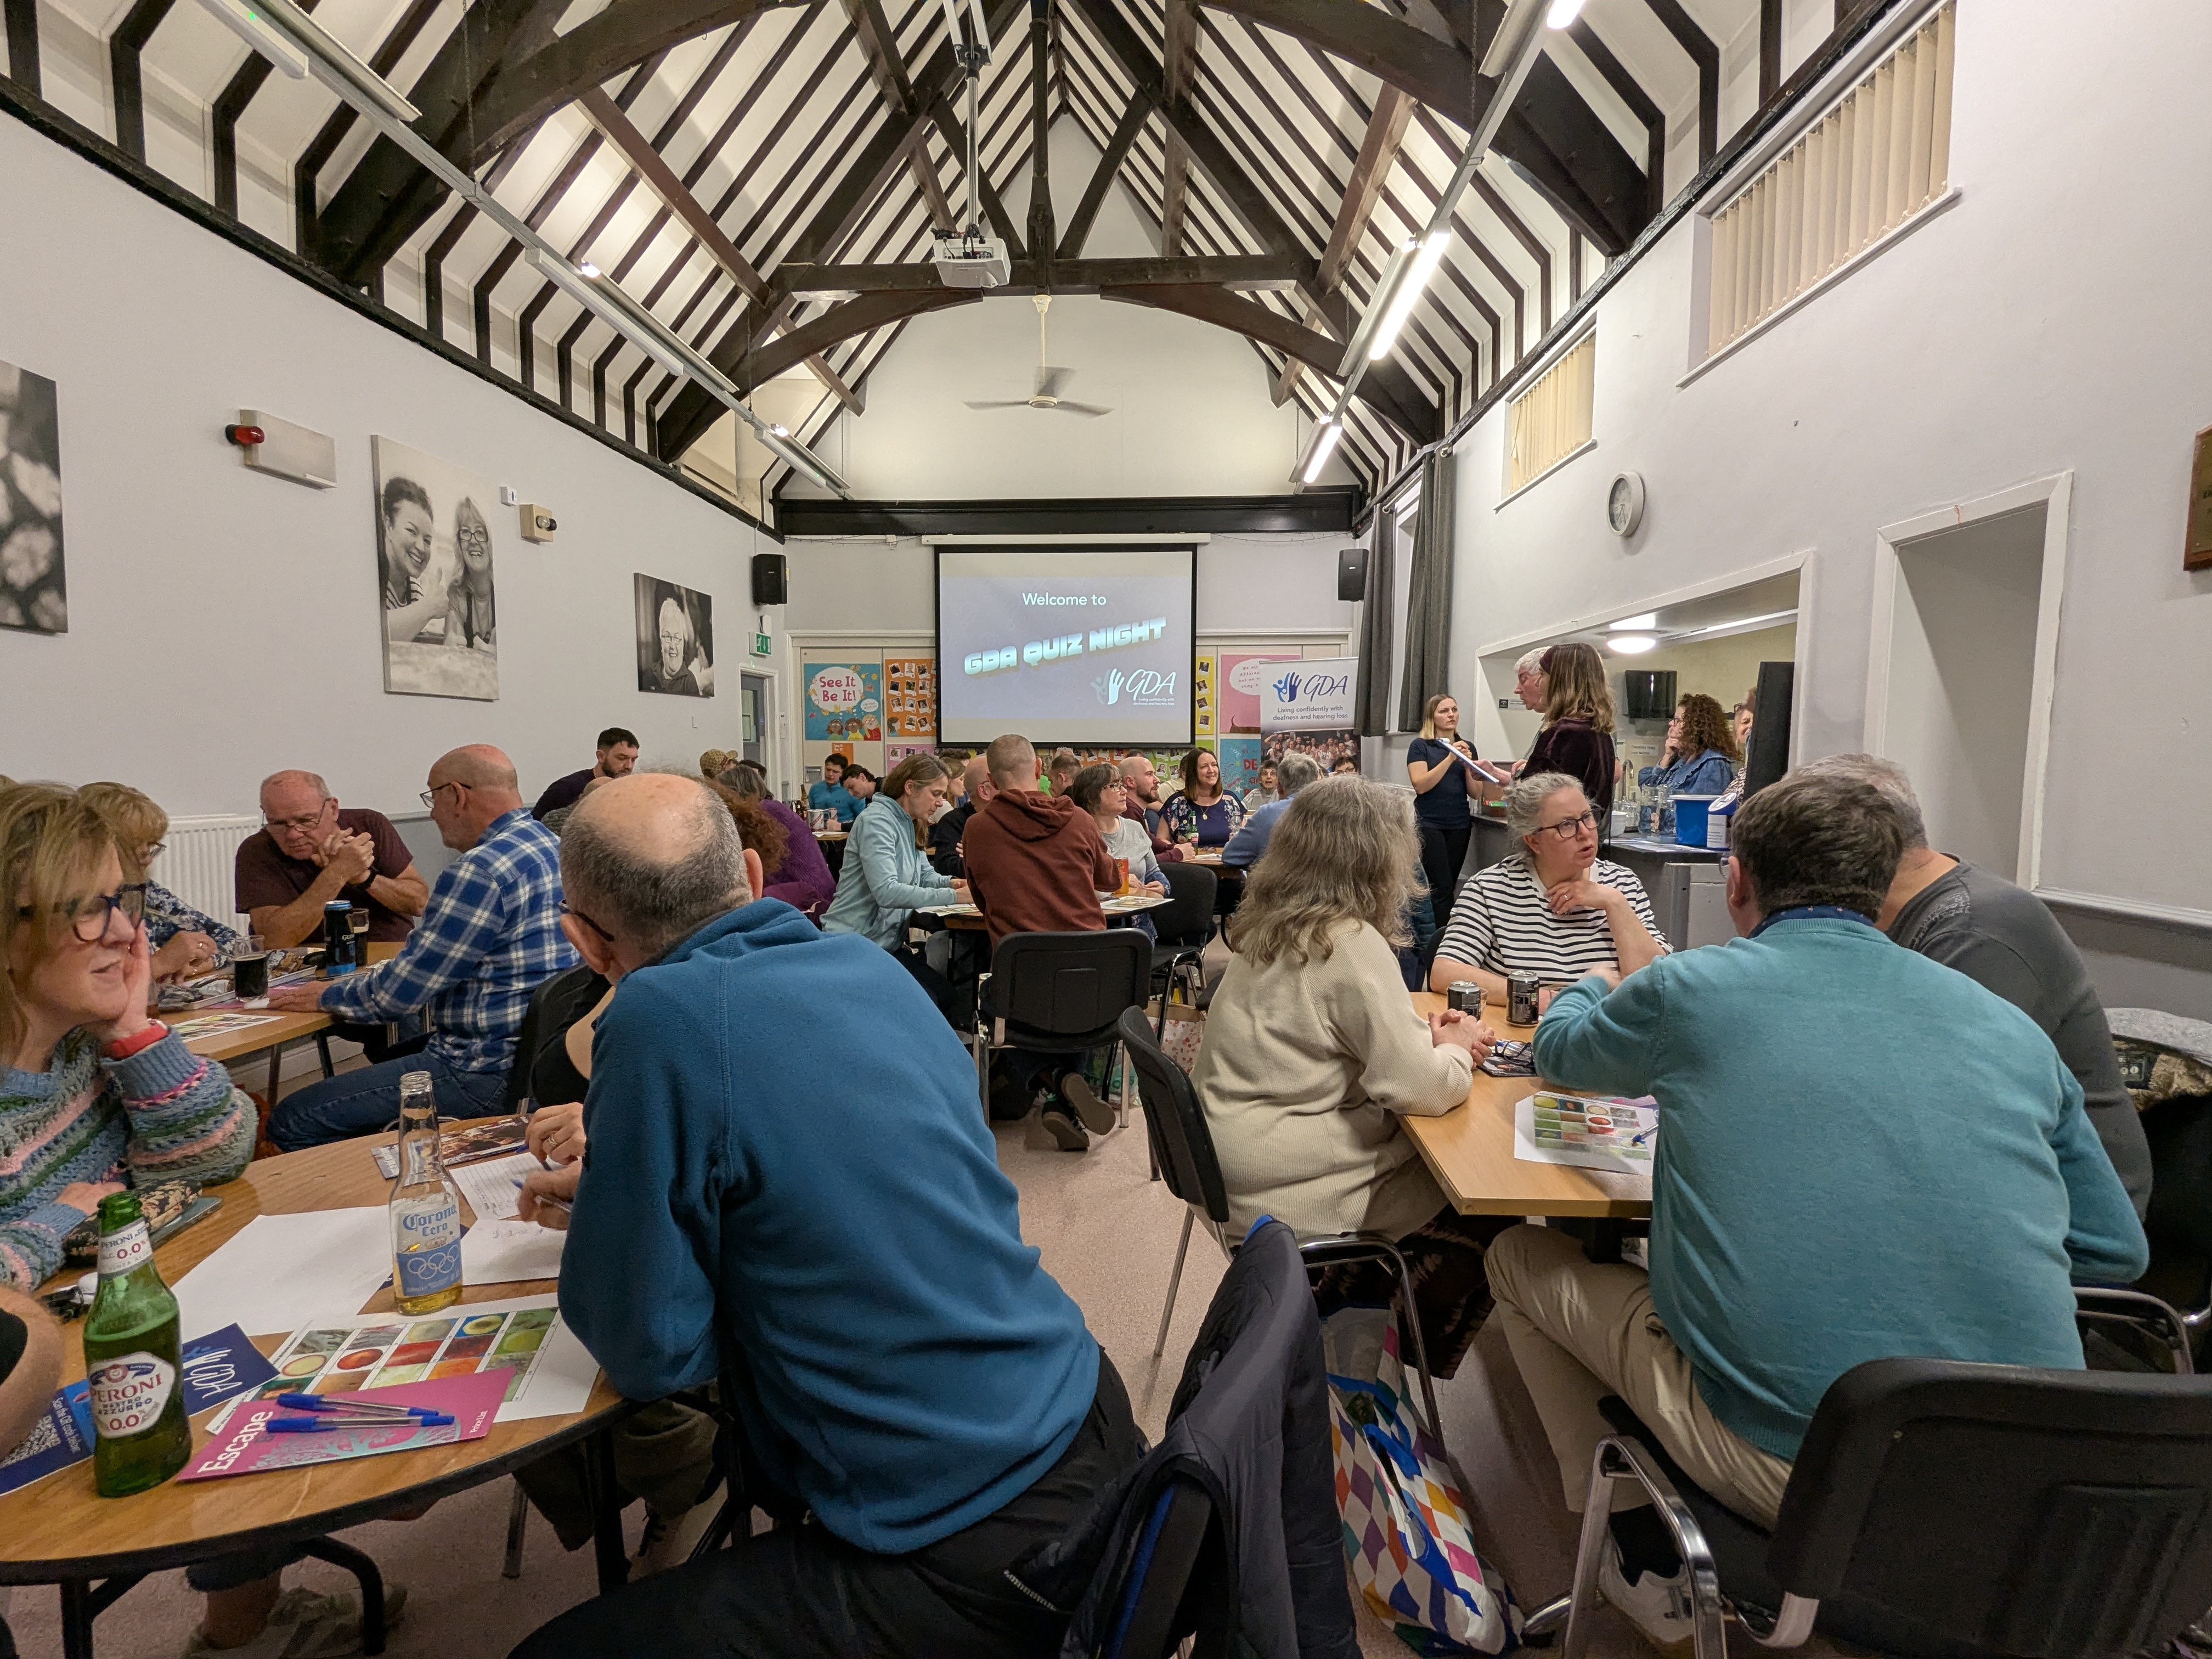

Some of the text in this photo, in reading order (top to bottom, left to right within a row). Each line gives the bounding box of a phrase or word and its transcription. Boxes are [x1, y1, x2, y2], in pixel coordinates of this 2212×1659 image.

[1022, 592, 1107, 606] Welcome to
[964, 617, 1166, 675] GDA QUIZ NIGHT
[819, 675, 856, 688] See It
[1126, 669, 1176, 701] GDA
[1304, 674, 1348, 702] GDA
[822, 689, 856, 702] Be It!
[1243, 759, 1258, 771] DE
[403, 1205, 457, 1232] Corona
[422, 1223, 448, 1237] Cero
[100, 1233, 133, 1249] PERONI
[90, 1373, 161, 1402] PERONI
[98, 1398, 152, 1415] AZZURRO
[197, 1410, 274, 1474] Escape
